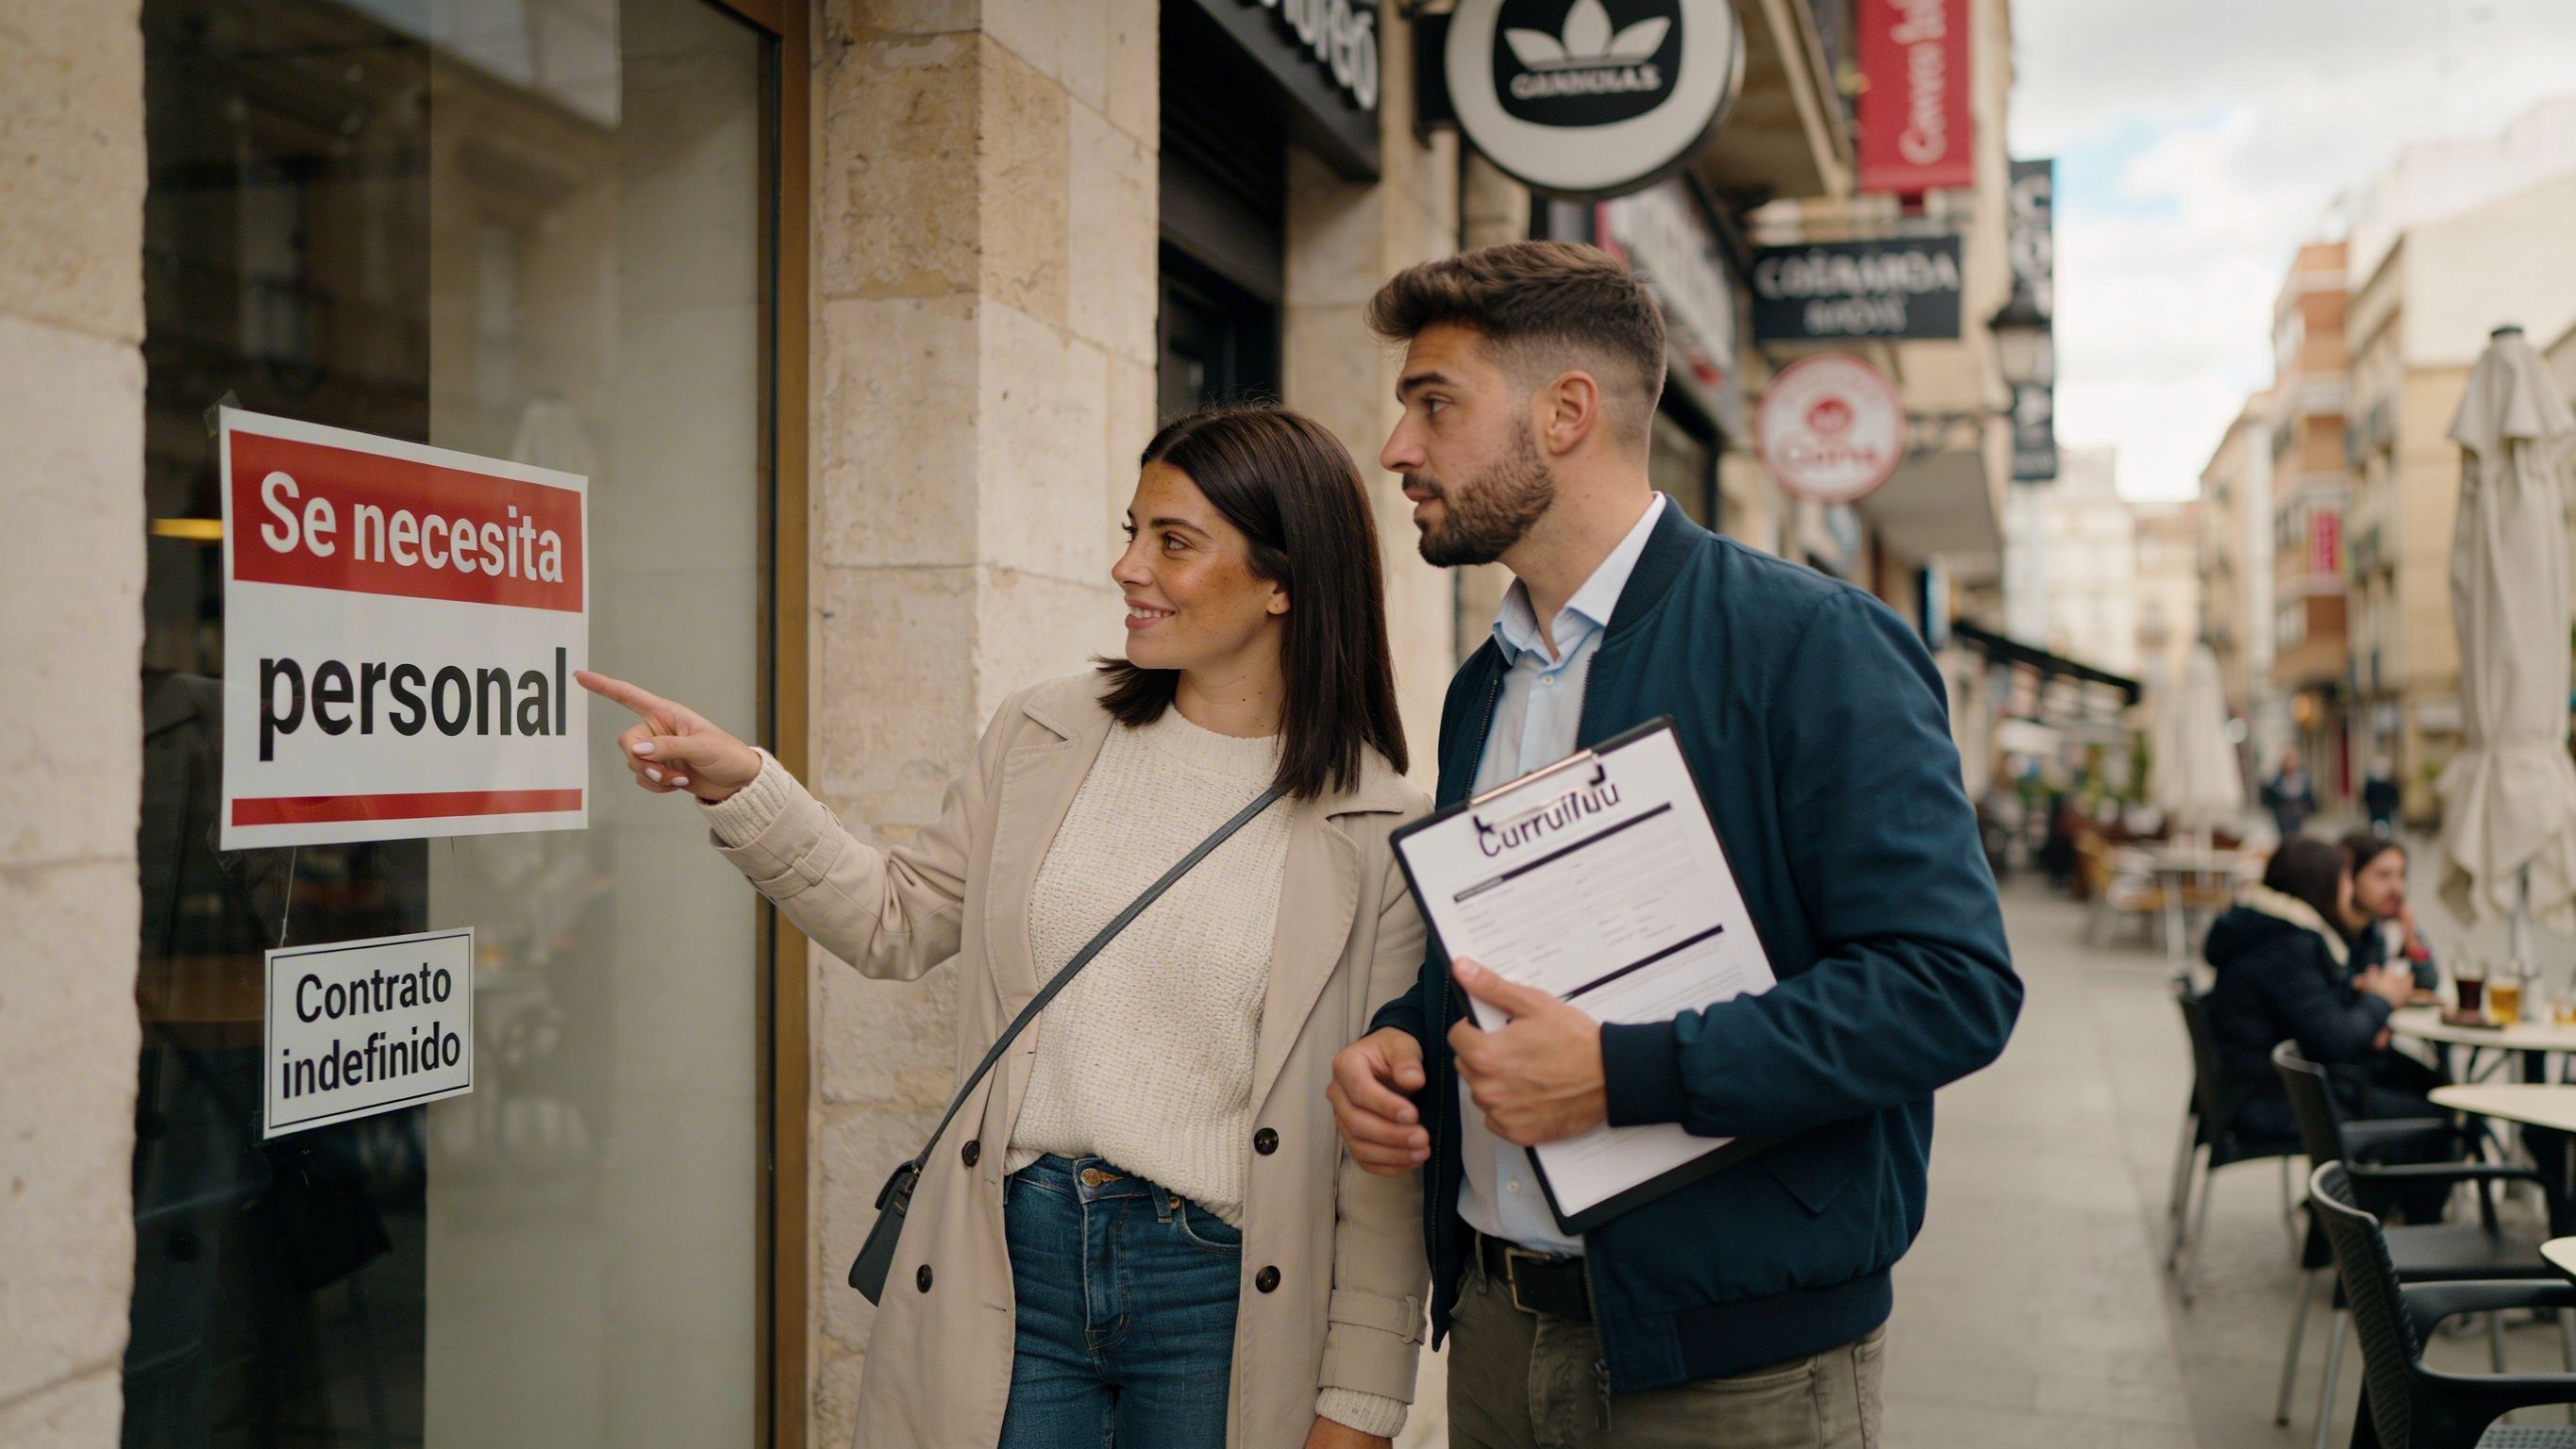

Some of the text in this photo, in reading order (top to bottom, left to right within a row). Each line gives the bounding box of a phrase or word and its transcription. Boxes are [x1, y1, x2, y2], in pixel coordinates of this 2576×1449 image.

[260, 471, 564, 584] Se necesita
[259, 646, 566, 762] personal
[295, 961, 452, 1024] Contrato
[282, 1022, 460, 1099] indefinido
